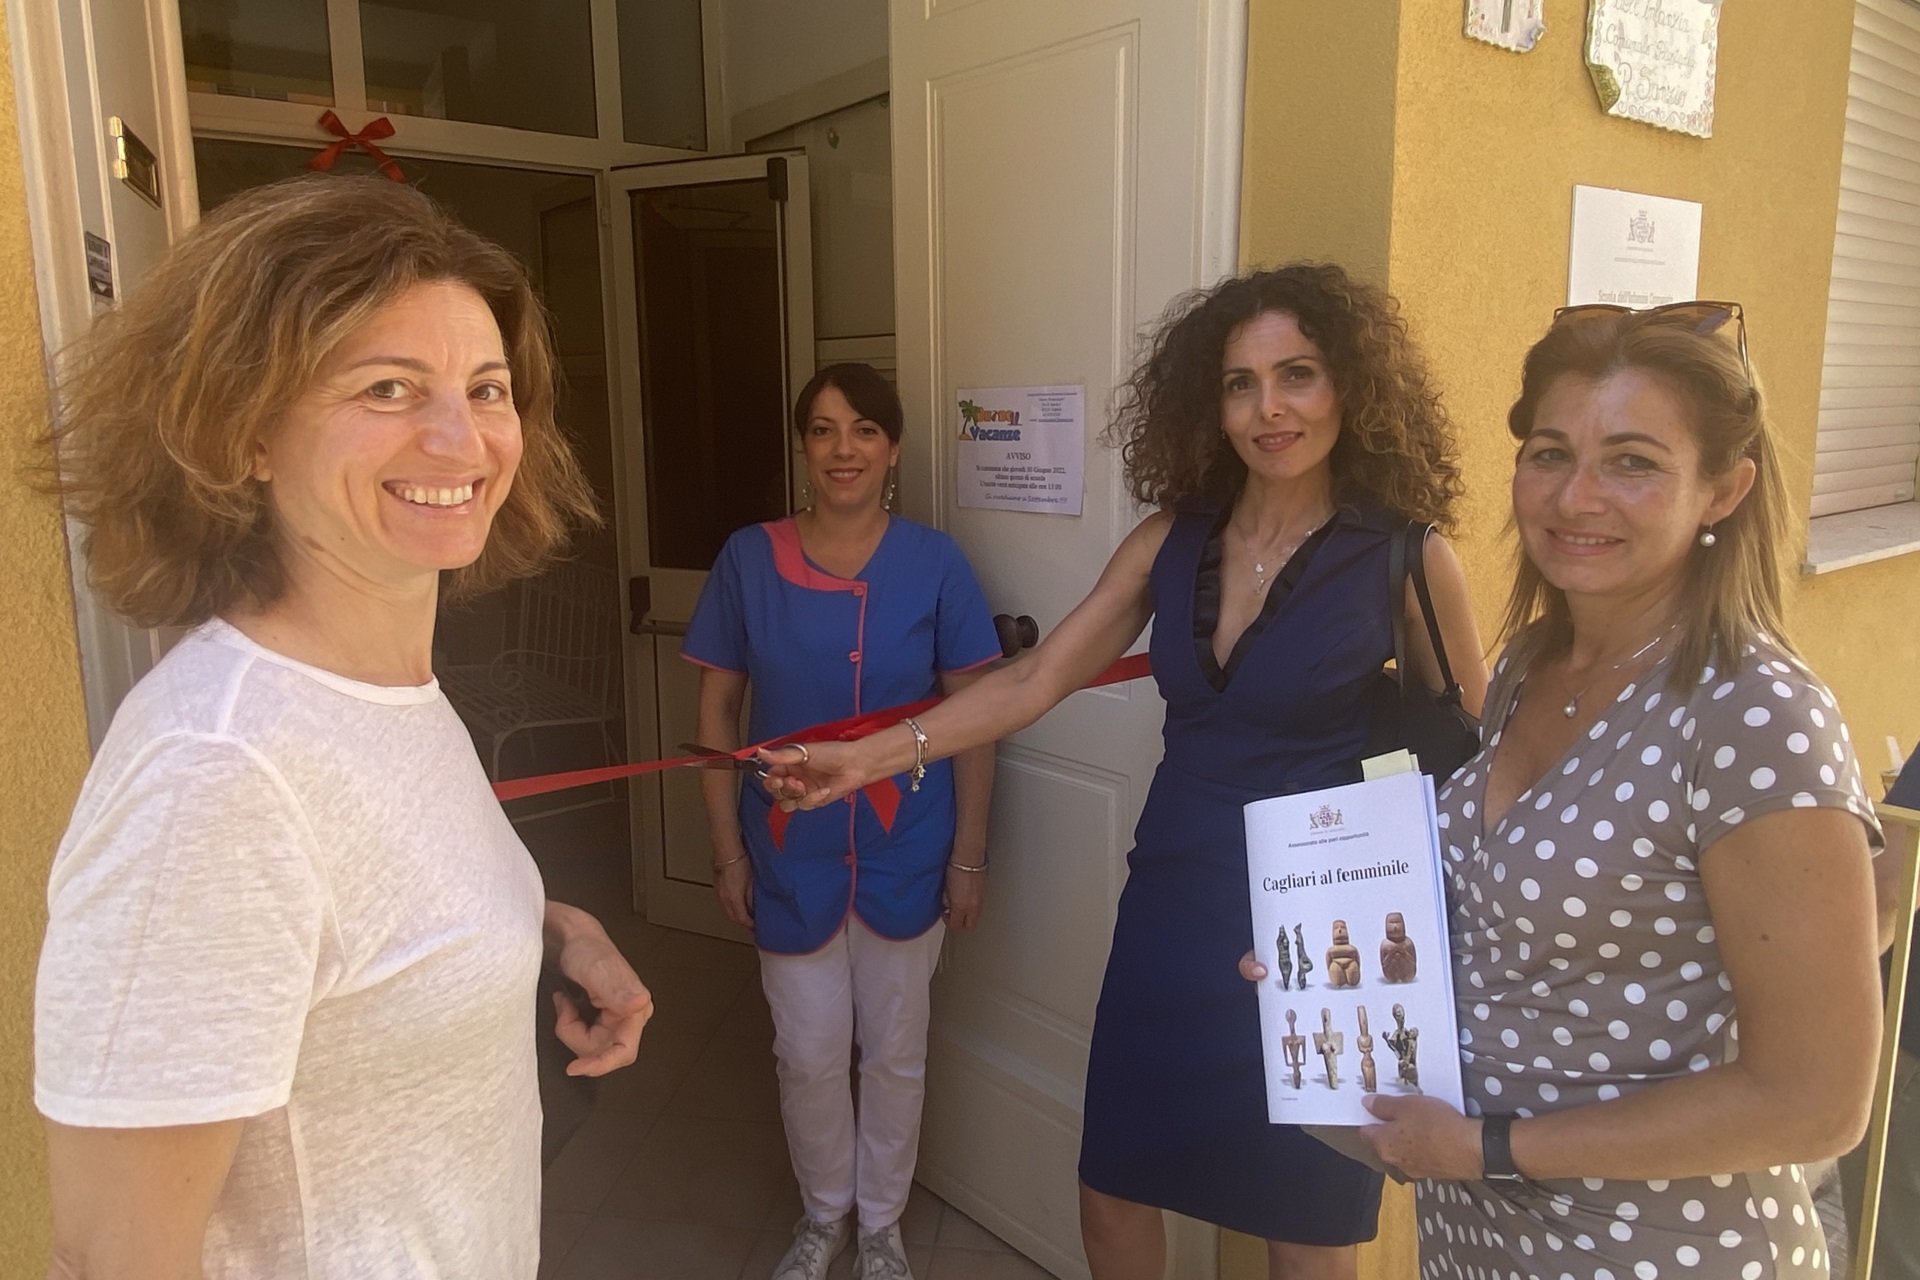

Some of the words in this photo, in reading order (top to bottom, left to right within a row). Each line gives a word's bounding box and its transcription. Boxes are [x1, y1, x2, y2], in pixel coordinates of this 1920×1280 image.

[969, 425, 1021, 441] Vacanze
[1005, 452, 1032, 461] AVVISO
[1288, 839, 1318, 848] Assessorato
[1262, 869, 1317, 895] Cagliari
[1319, 869, 1333, 886] al
[1336, 859, 1409, 883] femminile
